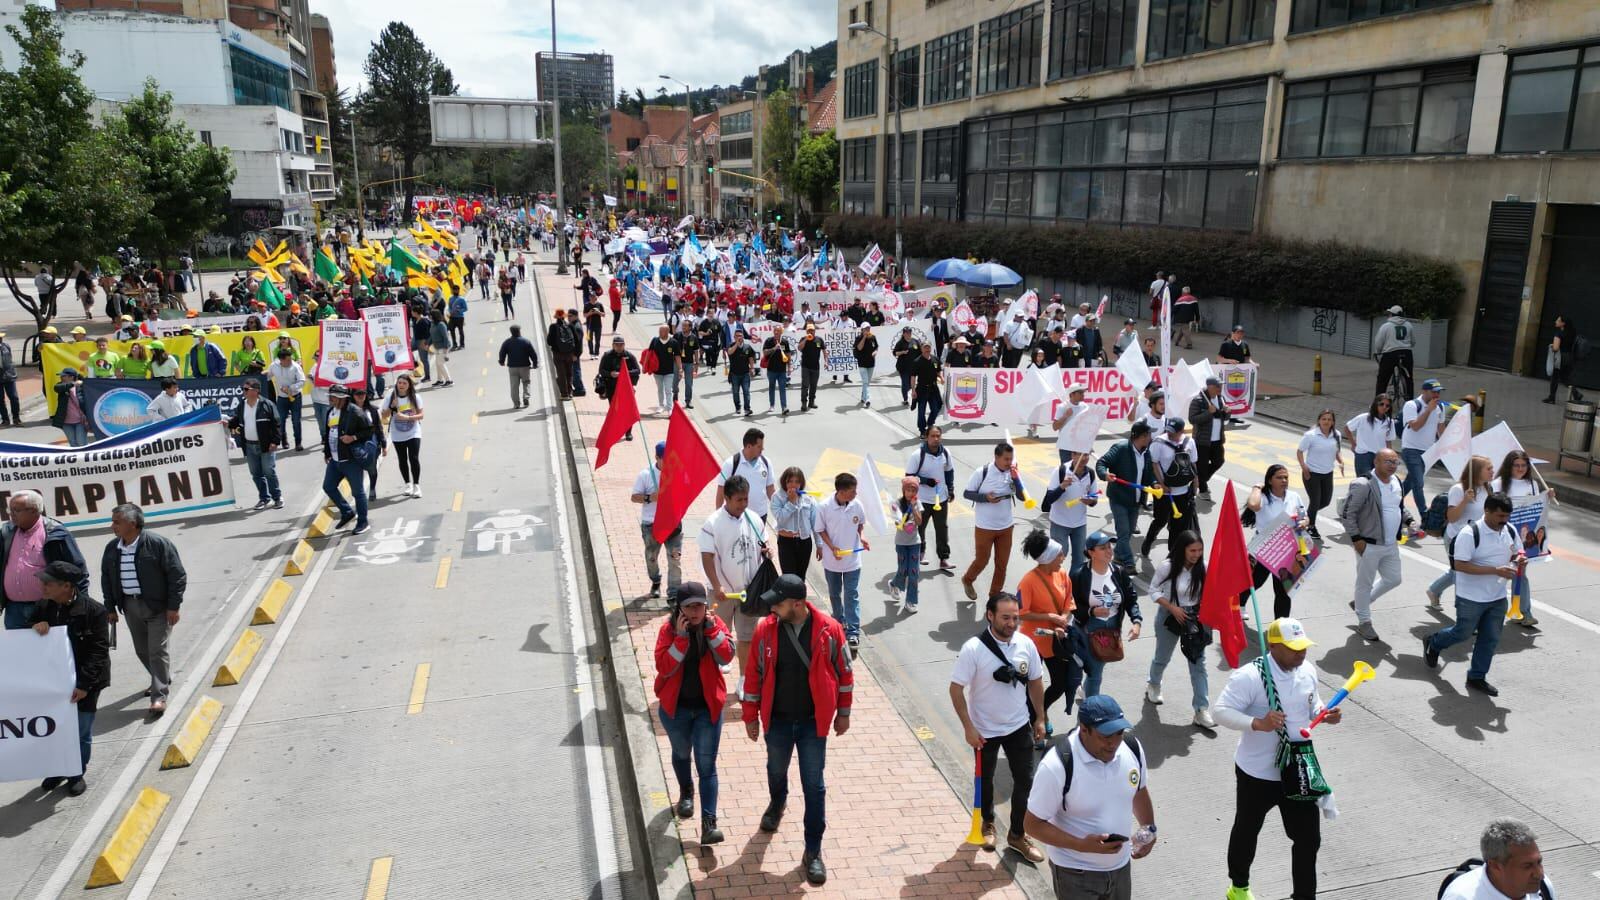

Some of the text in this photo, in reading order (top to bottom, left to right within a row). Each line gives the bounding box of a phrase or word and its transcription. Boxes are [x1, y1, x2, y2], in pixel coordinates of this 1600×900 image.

[904, 299, 928, 309] ucha
[825, 340, 855, 350] PERSIS
[826, 363, 858, 371] DESIST
[84, 434, 204, 463] Trabajadores
[1, 472, 11, 482] la
[70, 464, 112, 476] Distrital
[114, 462, 127, 472] de
[129, 453, 186, 470] Planeación
[0, 466, 223, 521] TAPLAND
